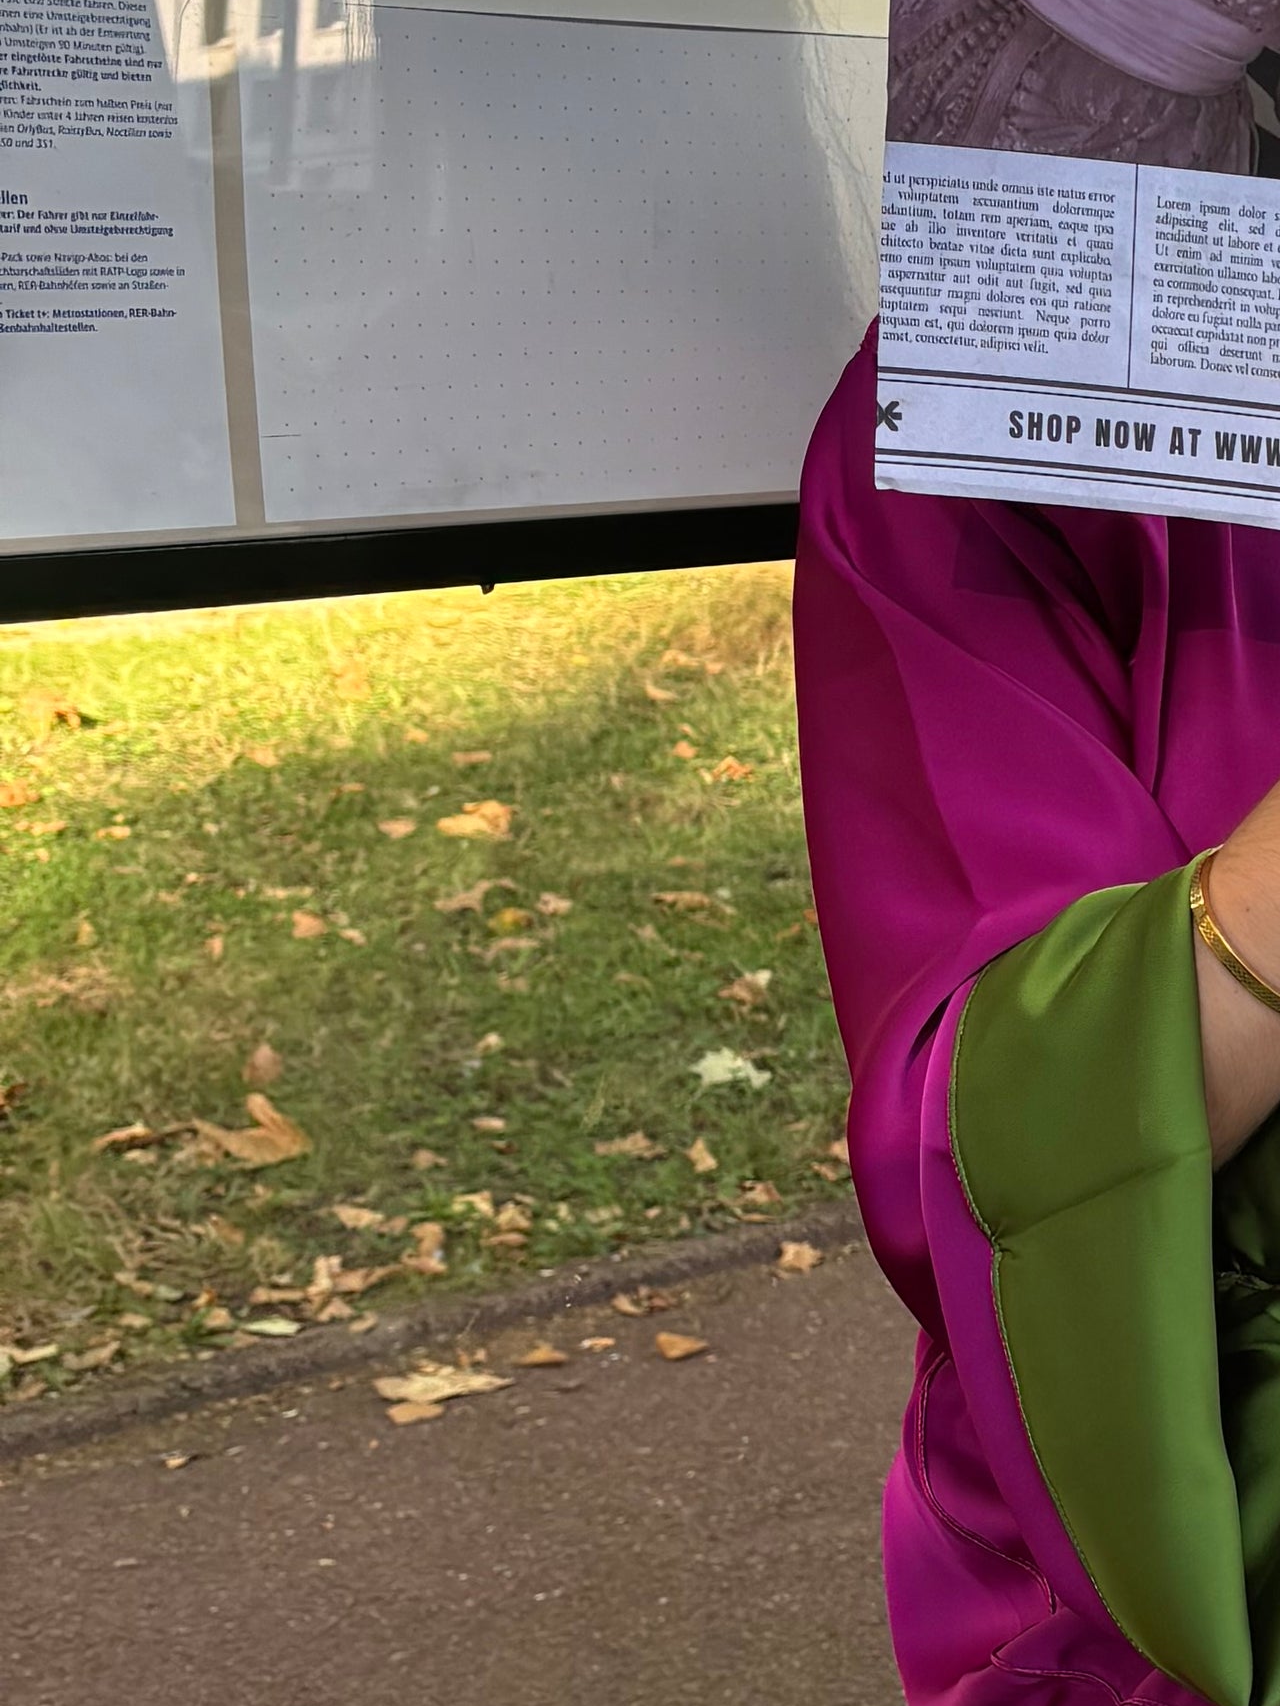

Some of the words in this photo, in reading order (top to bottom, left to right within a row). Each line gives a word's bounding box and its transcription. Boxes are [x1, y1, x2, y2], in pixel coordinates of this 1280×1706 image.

[894, 173, 905, 185] ut
[1156, 195, 1192, 212] Lorem
[1199, 200, 1230, 217] ipsum
[1238, 205, 1267, 220] dolor
[1155, 213, 1208, 233] adipiscing
[1248, 223, 1265, 236] sed
[1155, 230, 1208, 246] incididunt
[1213, 235, 1224, 247] ut
[1228, 236, 1260, 251] labore
[1264, 241, 1273, 252] et
[6, 309, 34, 319] Ticket
[1008, 409, 1082, 446] SHOP
[1095, 417, 1157, 453] NOW
[1169, 426, 1202, 458] AT
